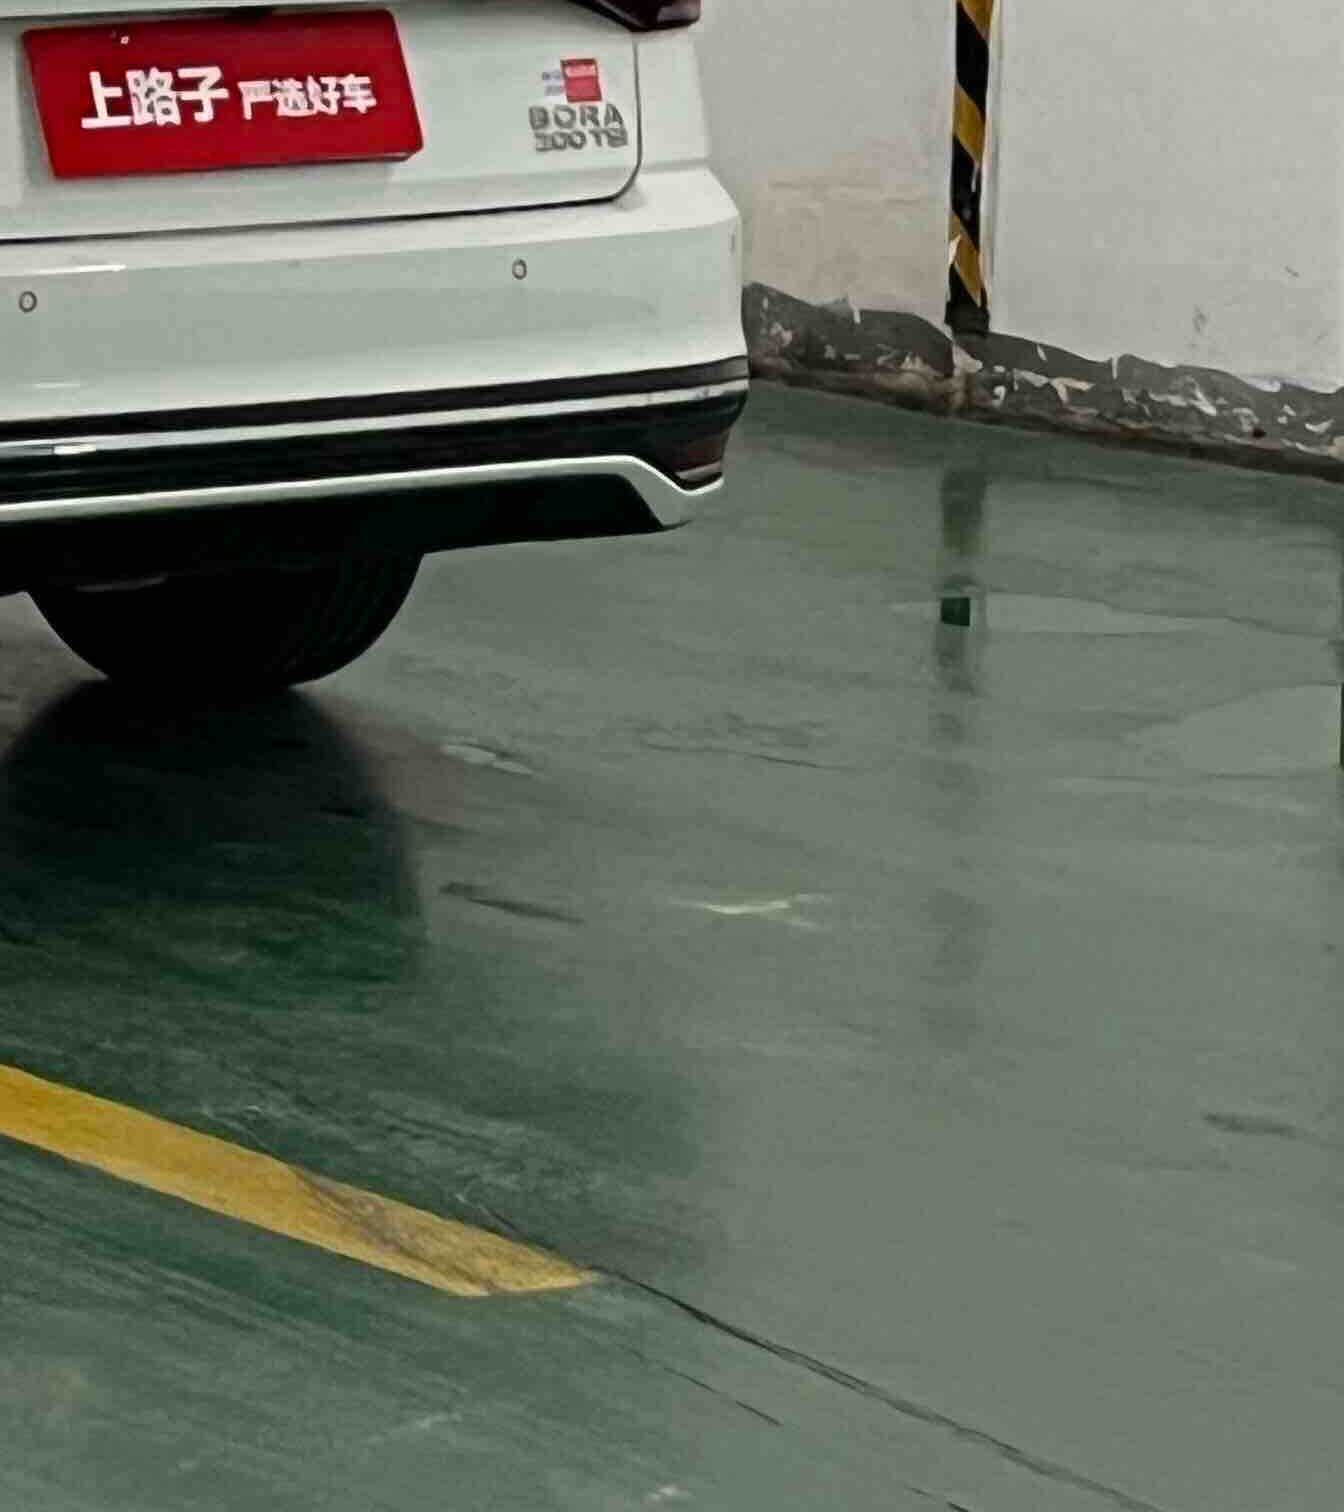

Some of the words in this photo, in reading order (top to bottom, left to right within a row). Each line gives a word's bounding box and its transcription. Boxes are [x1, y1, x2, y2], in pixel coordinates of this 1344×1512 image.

[81, 66, 229, 129] 上路子
[238, 74, 378, 120] 严选好车
[529, 103, 624, 130] BORA
